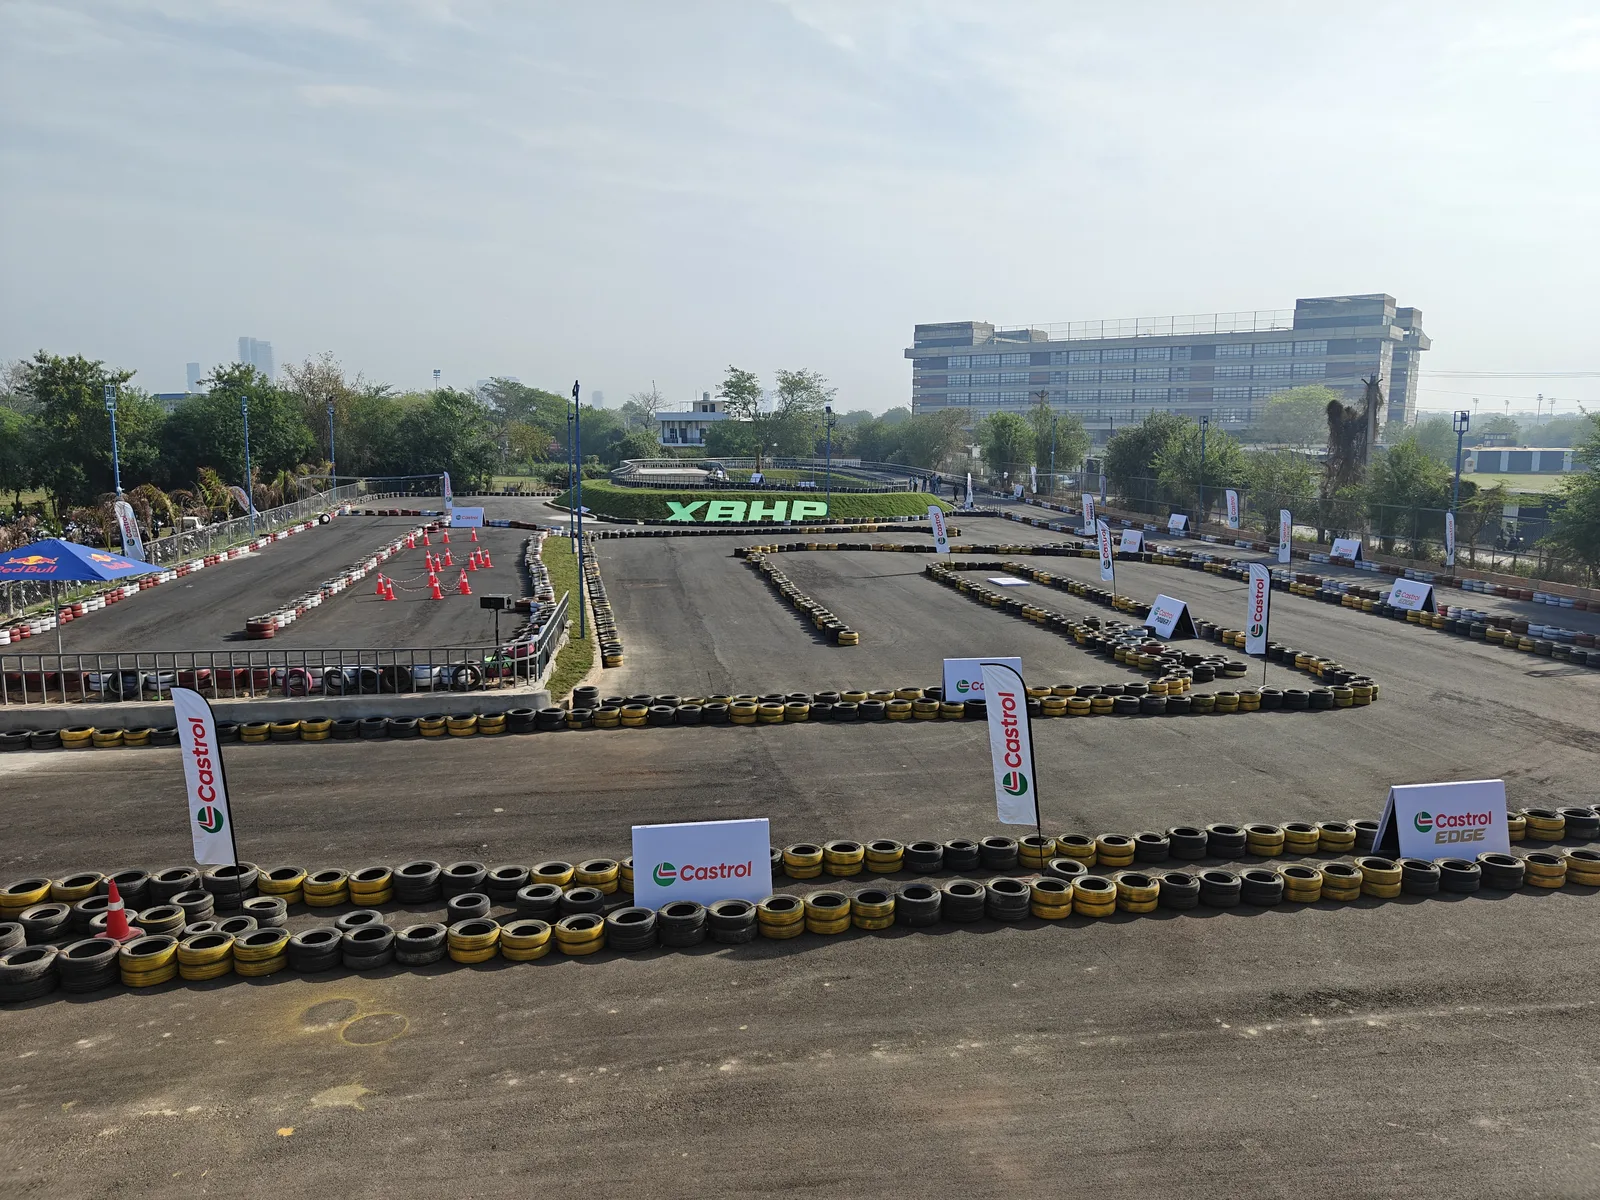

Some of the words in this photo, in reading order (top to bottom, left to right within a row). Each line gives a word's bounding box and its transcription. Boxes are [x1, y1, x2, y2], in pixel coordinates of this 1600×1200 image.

[665, 500, 828, 522] XBHP
[121, 515, 133, 539] Castrol
[934, 512, 944, 537] Castrol
[1101, 528, 1109, 559] Castrol
[24, 565, 58, 573] Bull
[1254, 578, 1264, 622] Castrol
[1401, 591, 1421, 601] Castrol
[1158, 609, 1174, 620] Castrol
[998, 692, 1022, 768] Castrol
[188, 717, 216, 802] Castrol
[1435, 810, 1492, 829] Castrol
[1434, 828, 1487, 845] EDGE
[680, 860, 752, 882] Castrol
